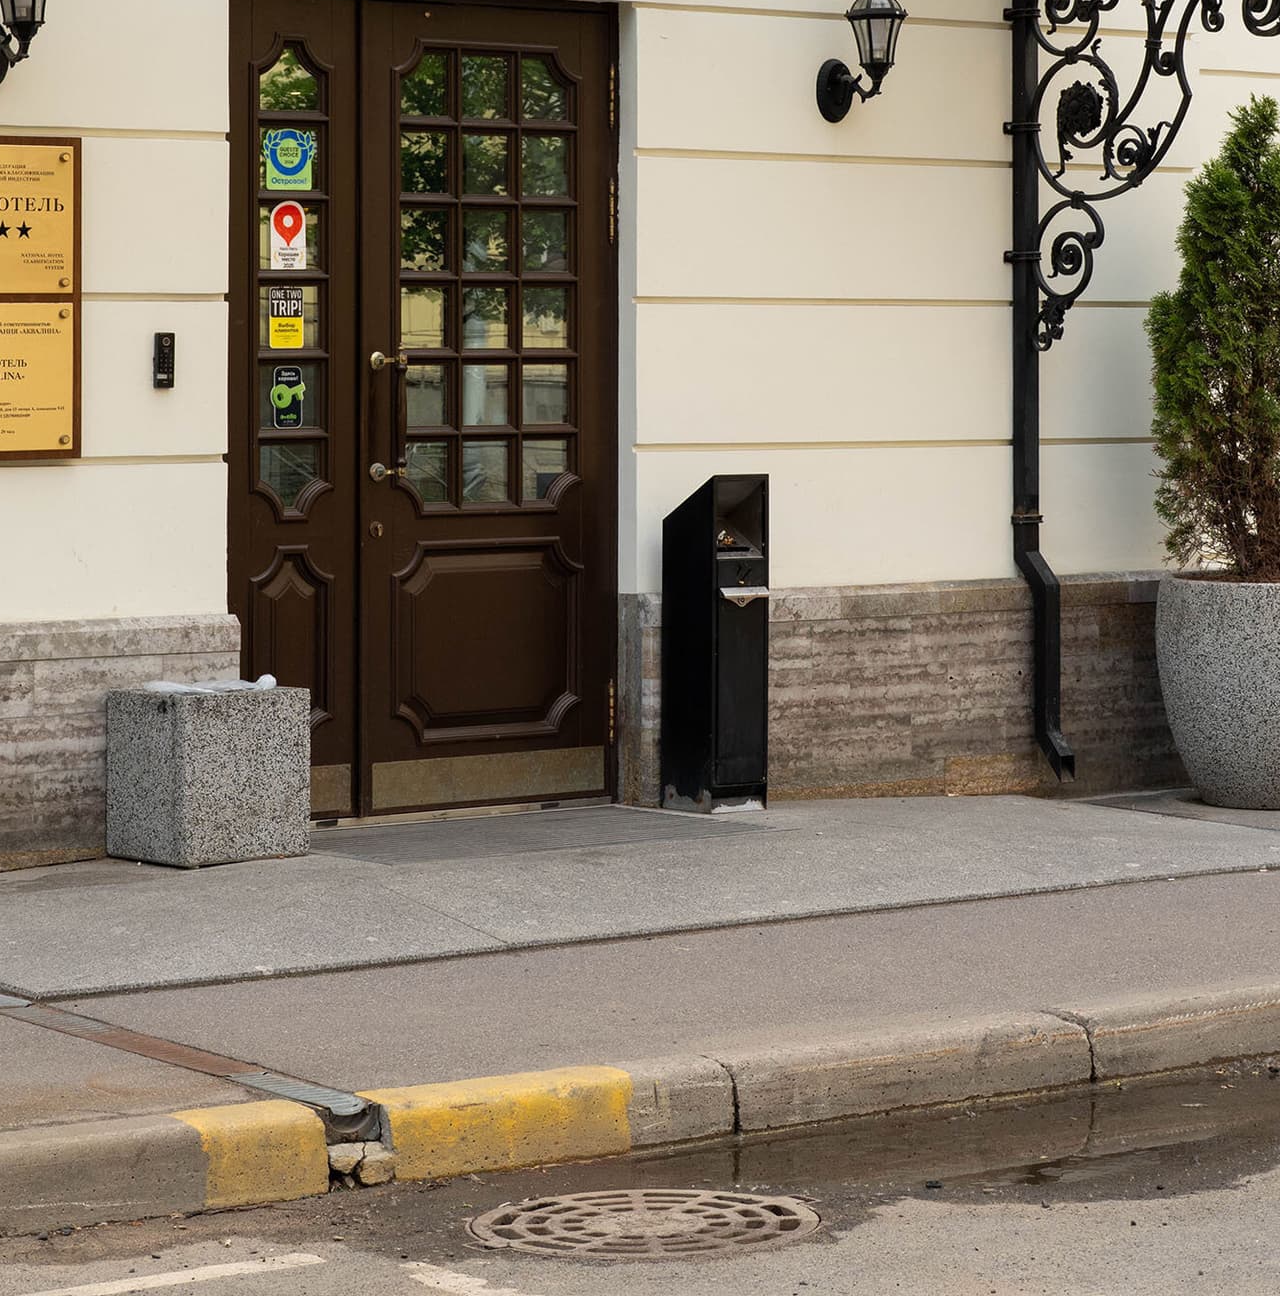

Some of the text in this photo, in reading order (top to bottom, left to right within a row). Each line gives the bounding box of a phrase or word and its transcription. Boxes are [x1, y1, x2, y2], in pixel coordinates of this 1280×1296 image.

[271, 289, 301, 299] ONE TWO
[271, 300, 302, 316] TRIP!
